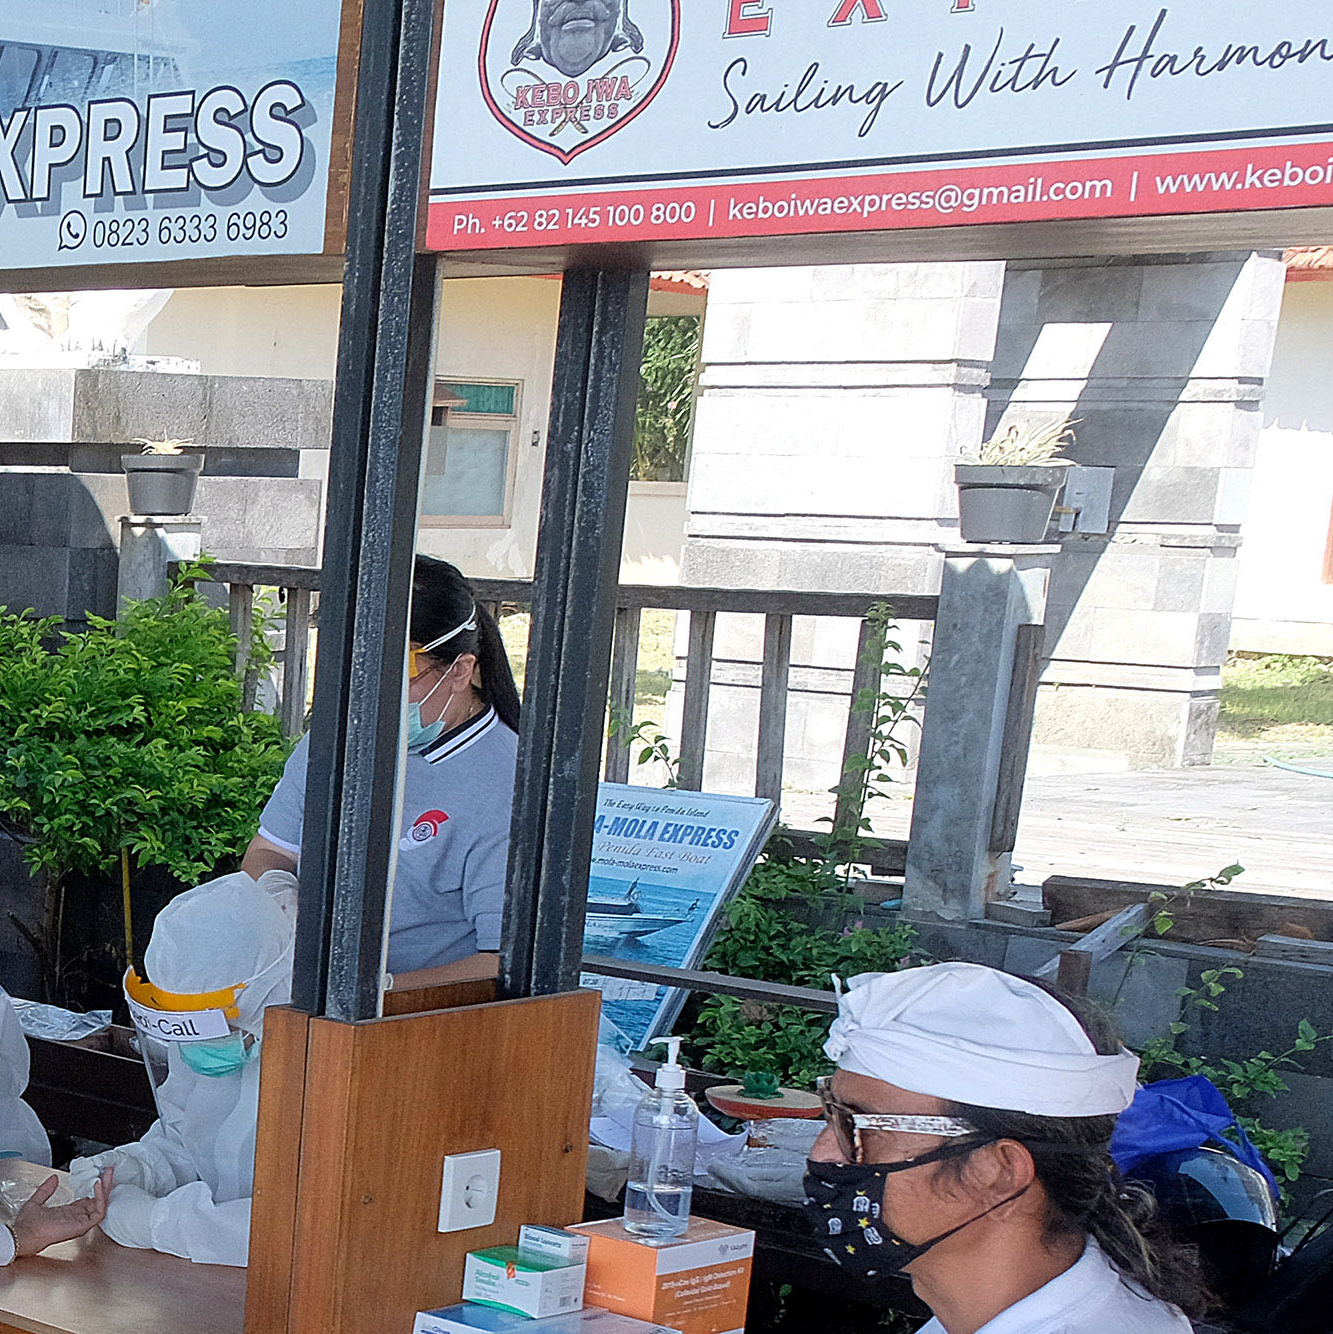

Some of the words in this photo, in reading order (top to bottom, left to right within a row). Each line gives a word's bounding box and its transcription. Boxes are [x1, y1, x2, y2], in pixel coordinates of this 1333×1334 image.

[514, 81, 579, 110] KEBO
[585, 76, 632, 102] IWA
[707, 57, 904, 138] Sailing
[926, 26, 1077, 109] With
[523, 104, 619, 126] EXPRESS
[453, 214, 486, 235] Ph.
[492, 210, 529, 232] +62
[534, 208, 561, 231] 82
[566, 206, 601, 228] 145
[607, 204, 645, 226] 100
[651, 201, 696, 224] 800
[728, 176, 1112, 221] keboiwaexpress@gmail.com
[92, 217, 149, 249] 0823
[158, 213, 217, 245] 6333
[226, 210, 288, 241] 6983
[603, 798, 616, 808] The
[616, 800, 634, 812] Easy
[658, 821, 740, 850] EXPRESS
[678, 850, 712, 865] Boat
